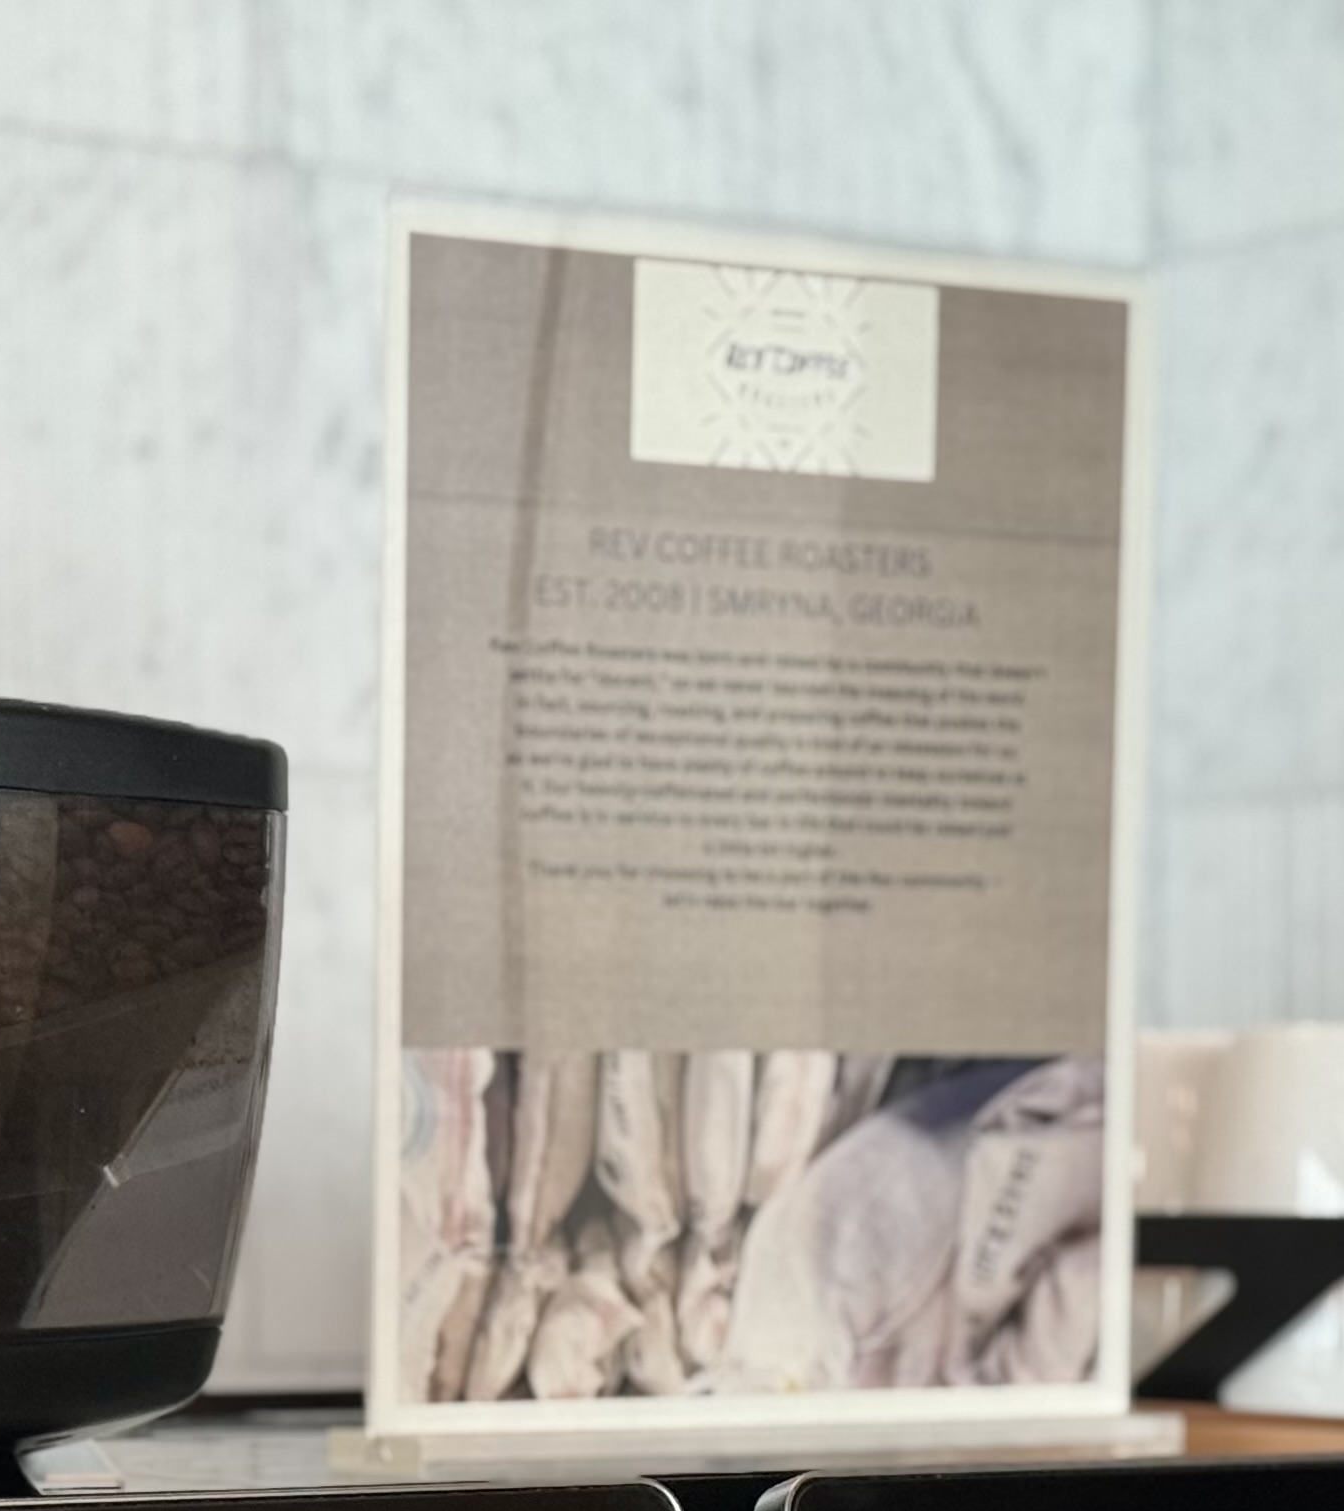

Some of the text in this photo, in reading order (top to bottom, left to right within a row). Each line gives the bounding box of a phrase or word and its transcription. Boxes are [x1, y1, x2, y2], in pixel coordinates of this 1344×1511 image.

[589, 528, 932, 578] REV COFFEE ROASTERS
[535, 577, 598, 610] EST.
[604, 579, 685, 613] 2008
[849, 592, 980, 629] GEORGIA
